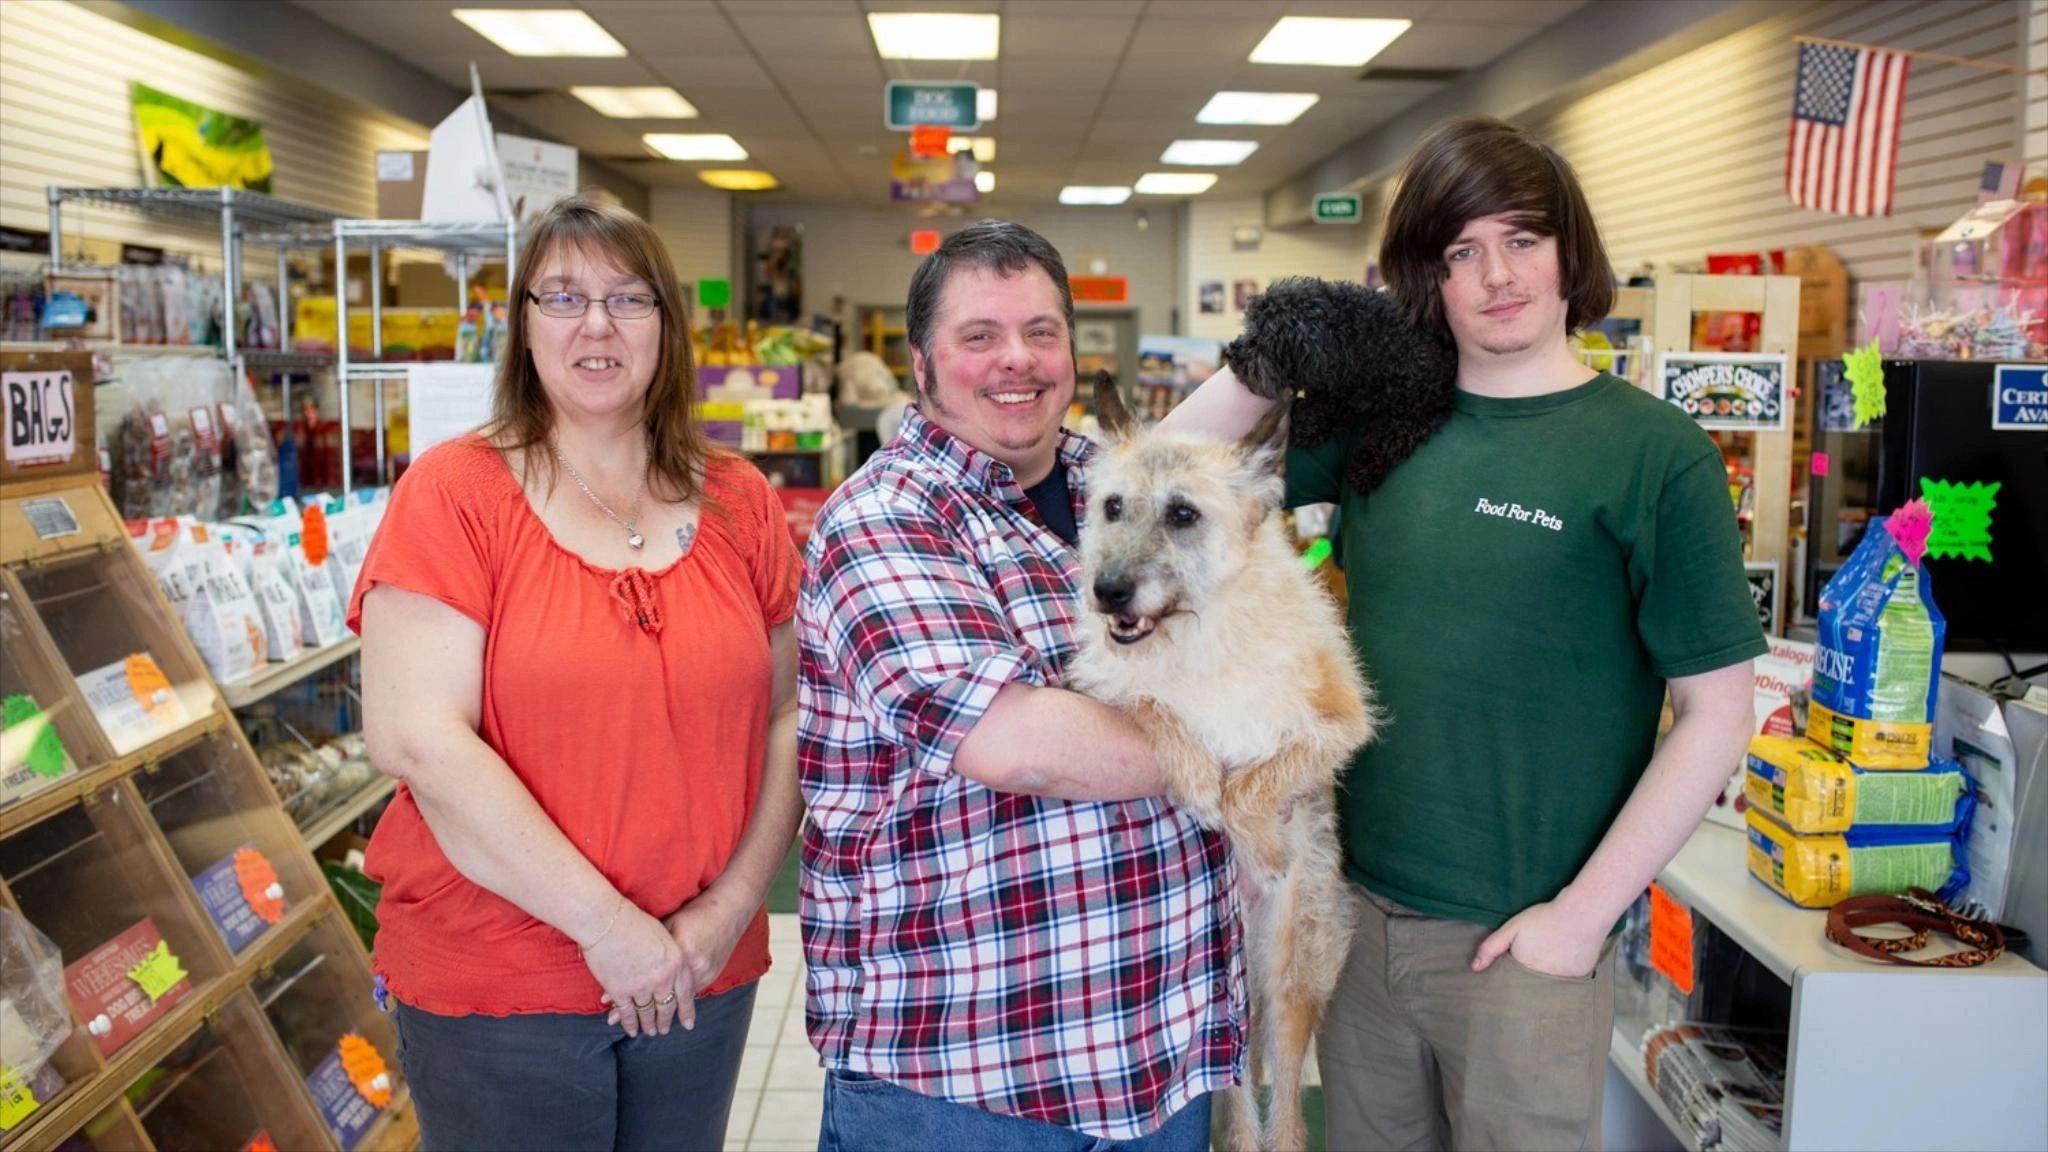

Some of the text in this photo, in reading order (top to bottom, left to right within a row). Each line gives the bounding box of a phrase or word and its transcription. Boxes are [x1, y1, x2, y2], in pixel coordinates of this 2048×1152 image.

[1734, 366, 1774, 401] CHOICE
[8, 374, 71, 447] BAGS
[1474, 497, 1563, 531] Food For Pets
